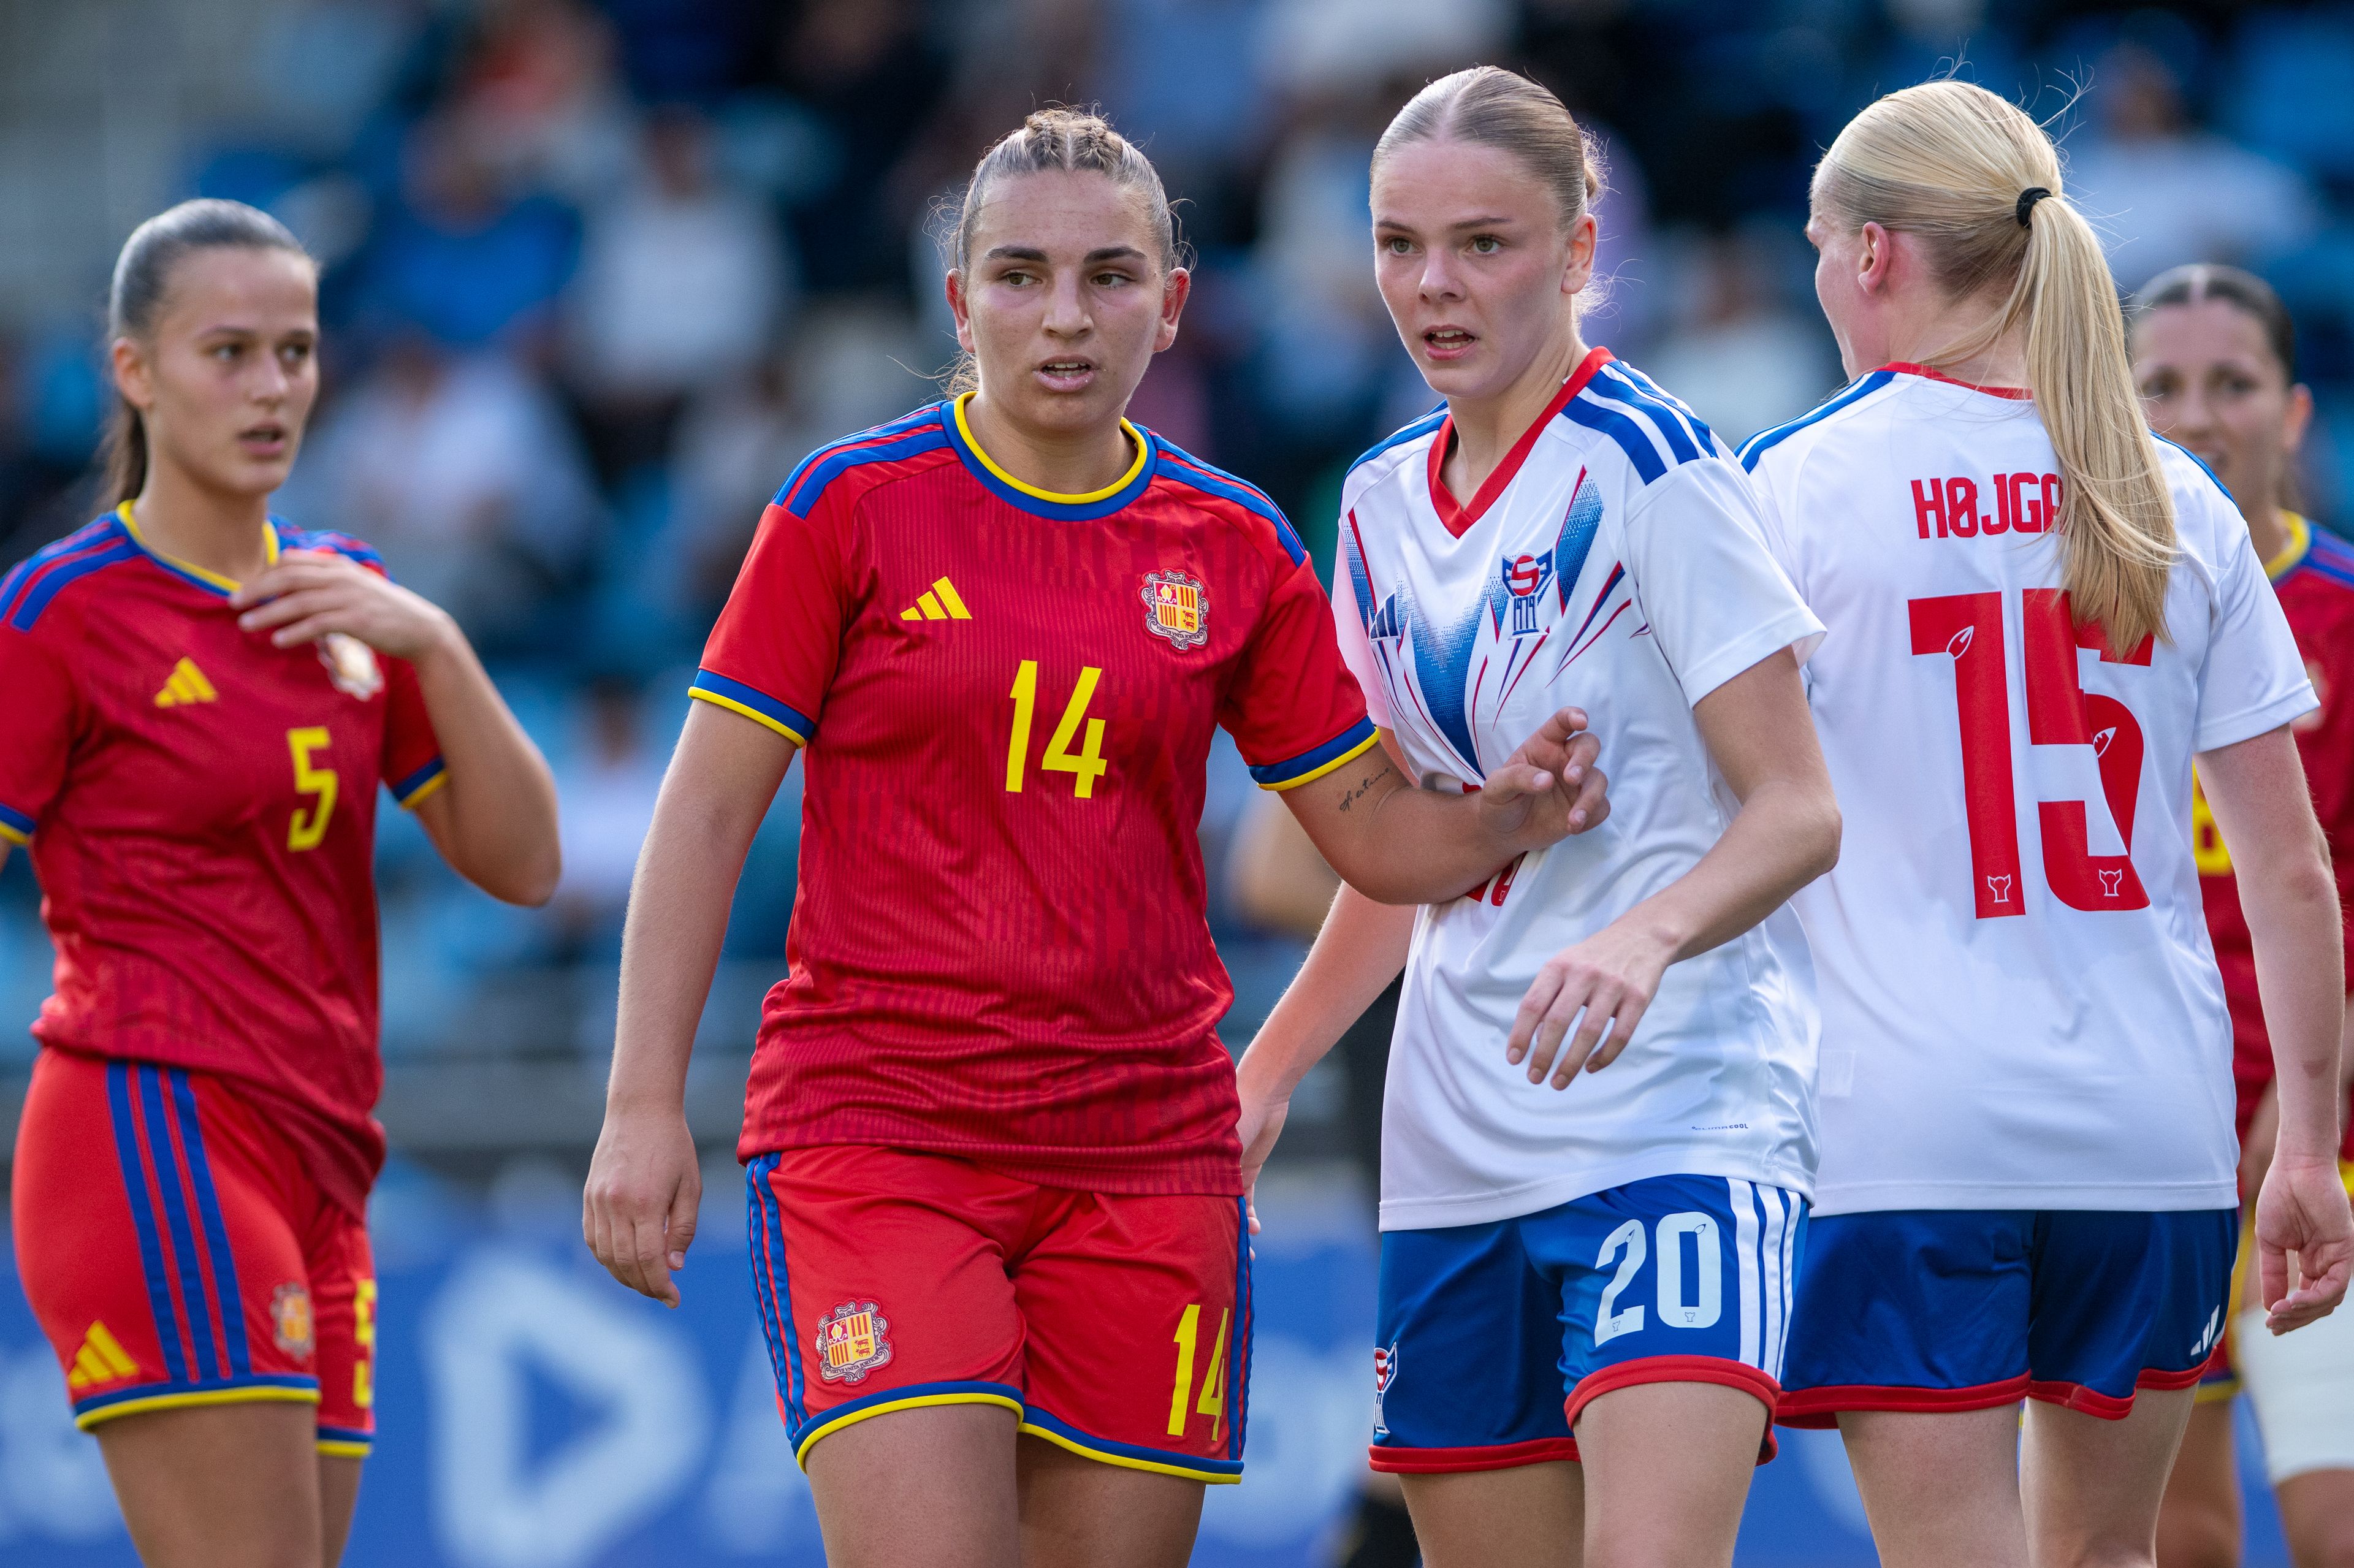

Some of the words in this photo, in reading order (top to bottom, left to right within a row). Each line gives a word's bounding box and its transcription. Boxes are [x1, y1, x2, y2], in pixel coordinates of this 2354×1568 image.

[1514, 595, 1537, 631] 1979
[287, 726, 339, 852] 5
[1006, 660, 1107, 799] 14
[1908, 588, 2155, 919] 15
[1594, 1211, 1722, 1347] 20
[1167, 1304, 1228, 1442] 14
